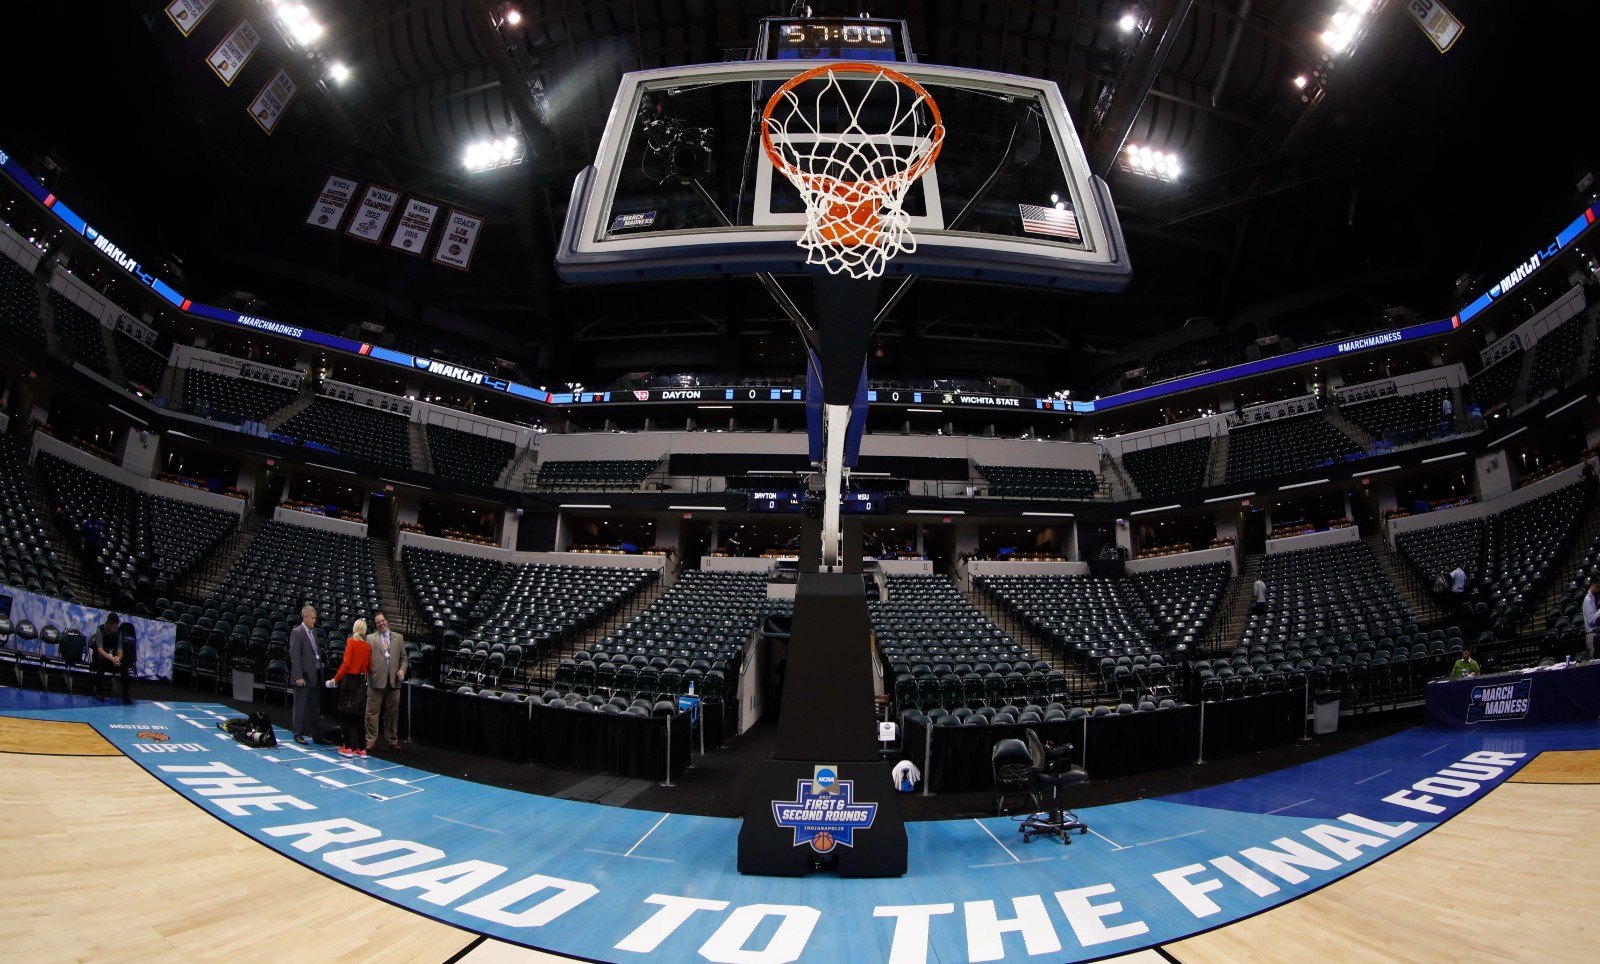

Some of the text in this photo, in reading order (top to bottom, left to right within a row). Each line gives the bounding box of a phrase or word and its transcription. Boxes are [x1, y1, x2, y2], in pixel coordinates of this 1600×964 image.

[241, 25, 256, 43] NBA
[278, 74, 292, 93] NBA
[332, 180, 350, 190] WNBA
[371, 190, 393, 203] WNBA
[412, 204, 431, 214] WNBA
[365, 210, 381, 220] 2012
[454, 216, 476, 229] COACH
[404, 230, 419, 239] 2015
[238, 315, 303, 338] #MARCHMADNESS
[1338, 332, 1402, 353] #MARCHMADNESS
[662, 390, 701, 399] DAYTON
[748, 390, 756, 399] 0
[892, 391, 900, 402] 0
[960, 395, 1020, 406] WICHITA STATE
[754, 492, 777, 500] DAYTON
[1482, 685, 1514, 701] MARCH
[1485, 698, 1528, 715] MADNESS
[132, 743, 210, 753] IUPUI
[804, 799, 845, 810] FIRST &
[782, 809, 868, 822] SECOND ROUNDS
[158, 750, 1528, 964] THE ROAD TO THE FINAL FOUR
